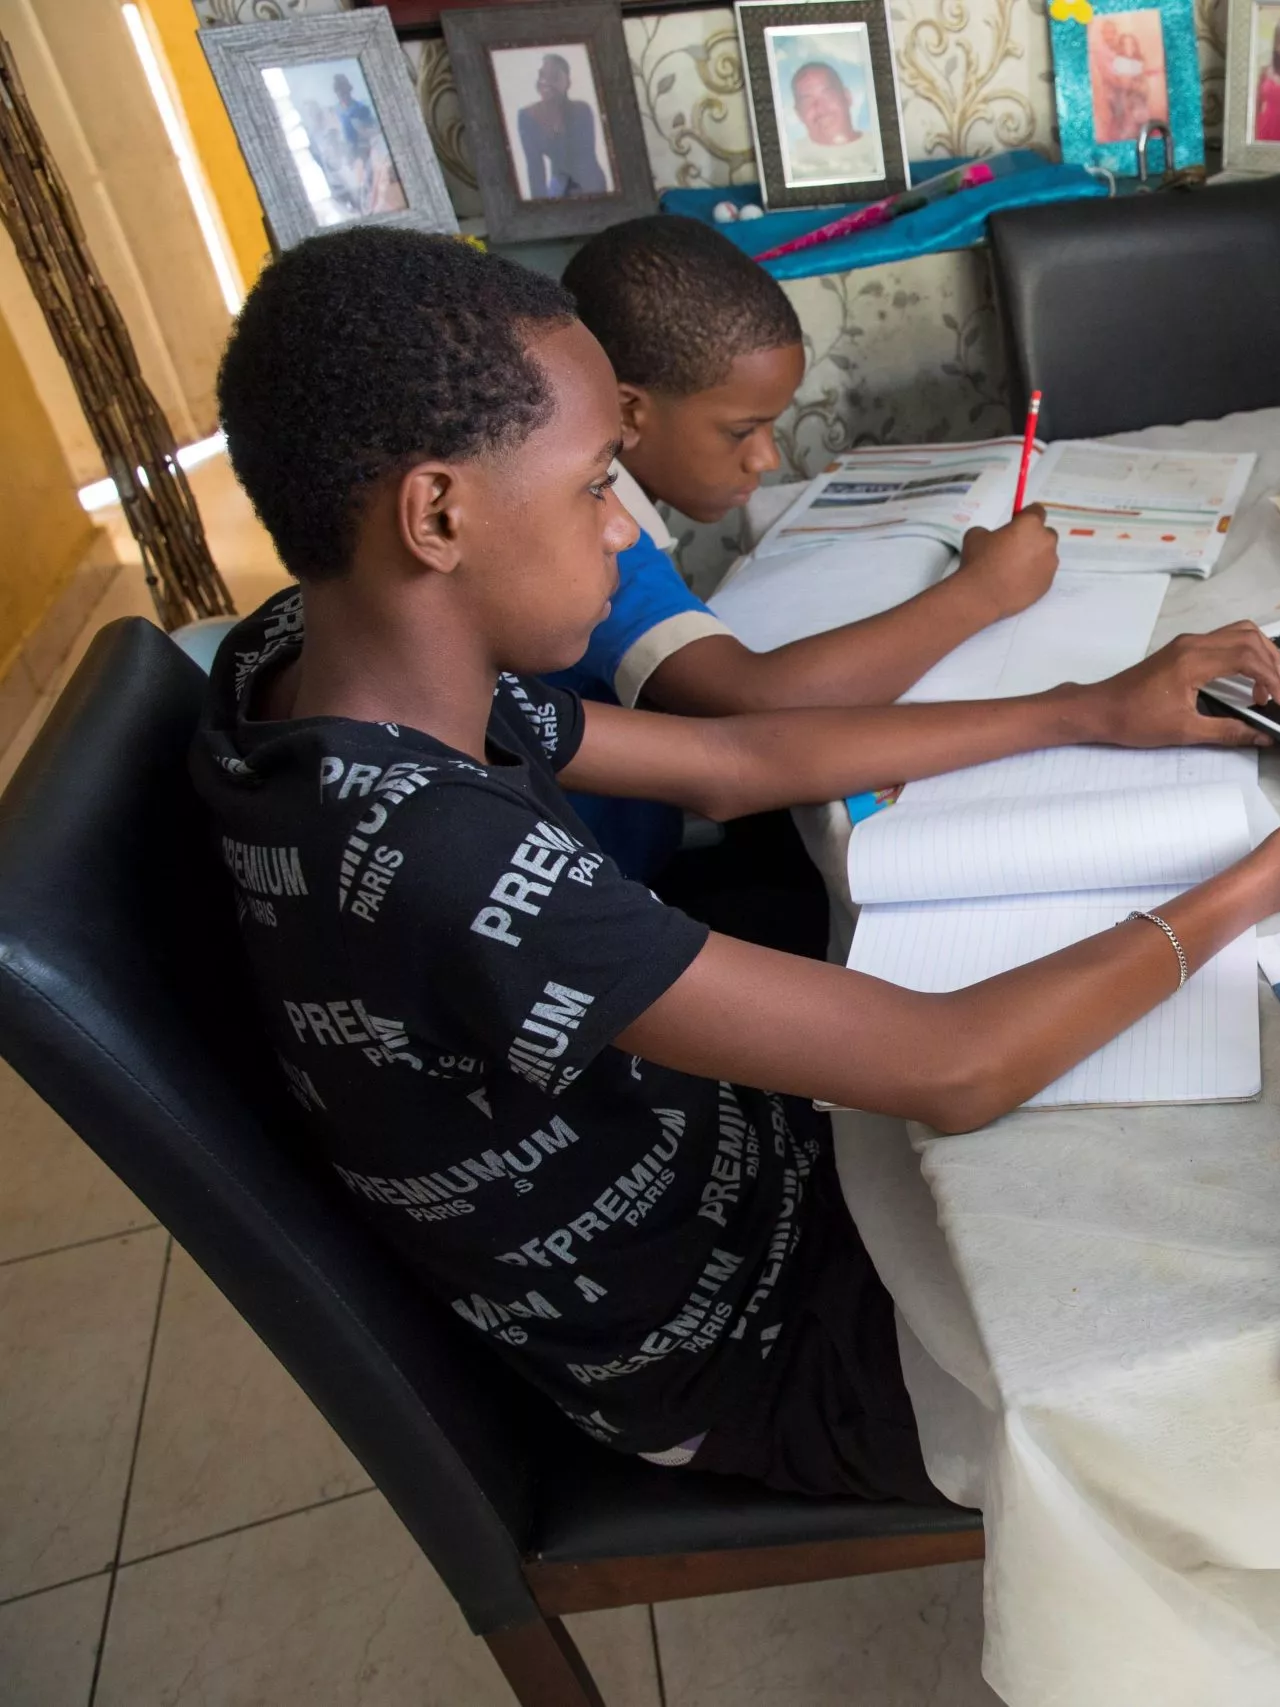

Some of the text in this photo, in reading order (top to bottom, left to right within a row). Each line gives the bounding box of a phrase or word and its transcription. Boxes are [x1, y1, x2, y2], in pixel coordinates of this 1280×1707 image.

[350, 845, 405, 923] PARIS
[405, 1199, 476, 1223] PARIS
[543, 1107, 687, 1265] PREMIUM
[624, 1168, 676, 1227] PARIS
[680, 1301, 733, 1354] PARIS
